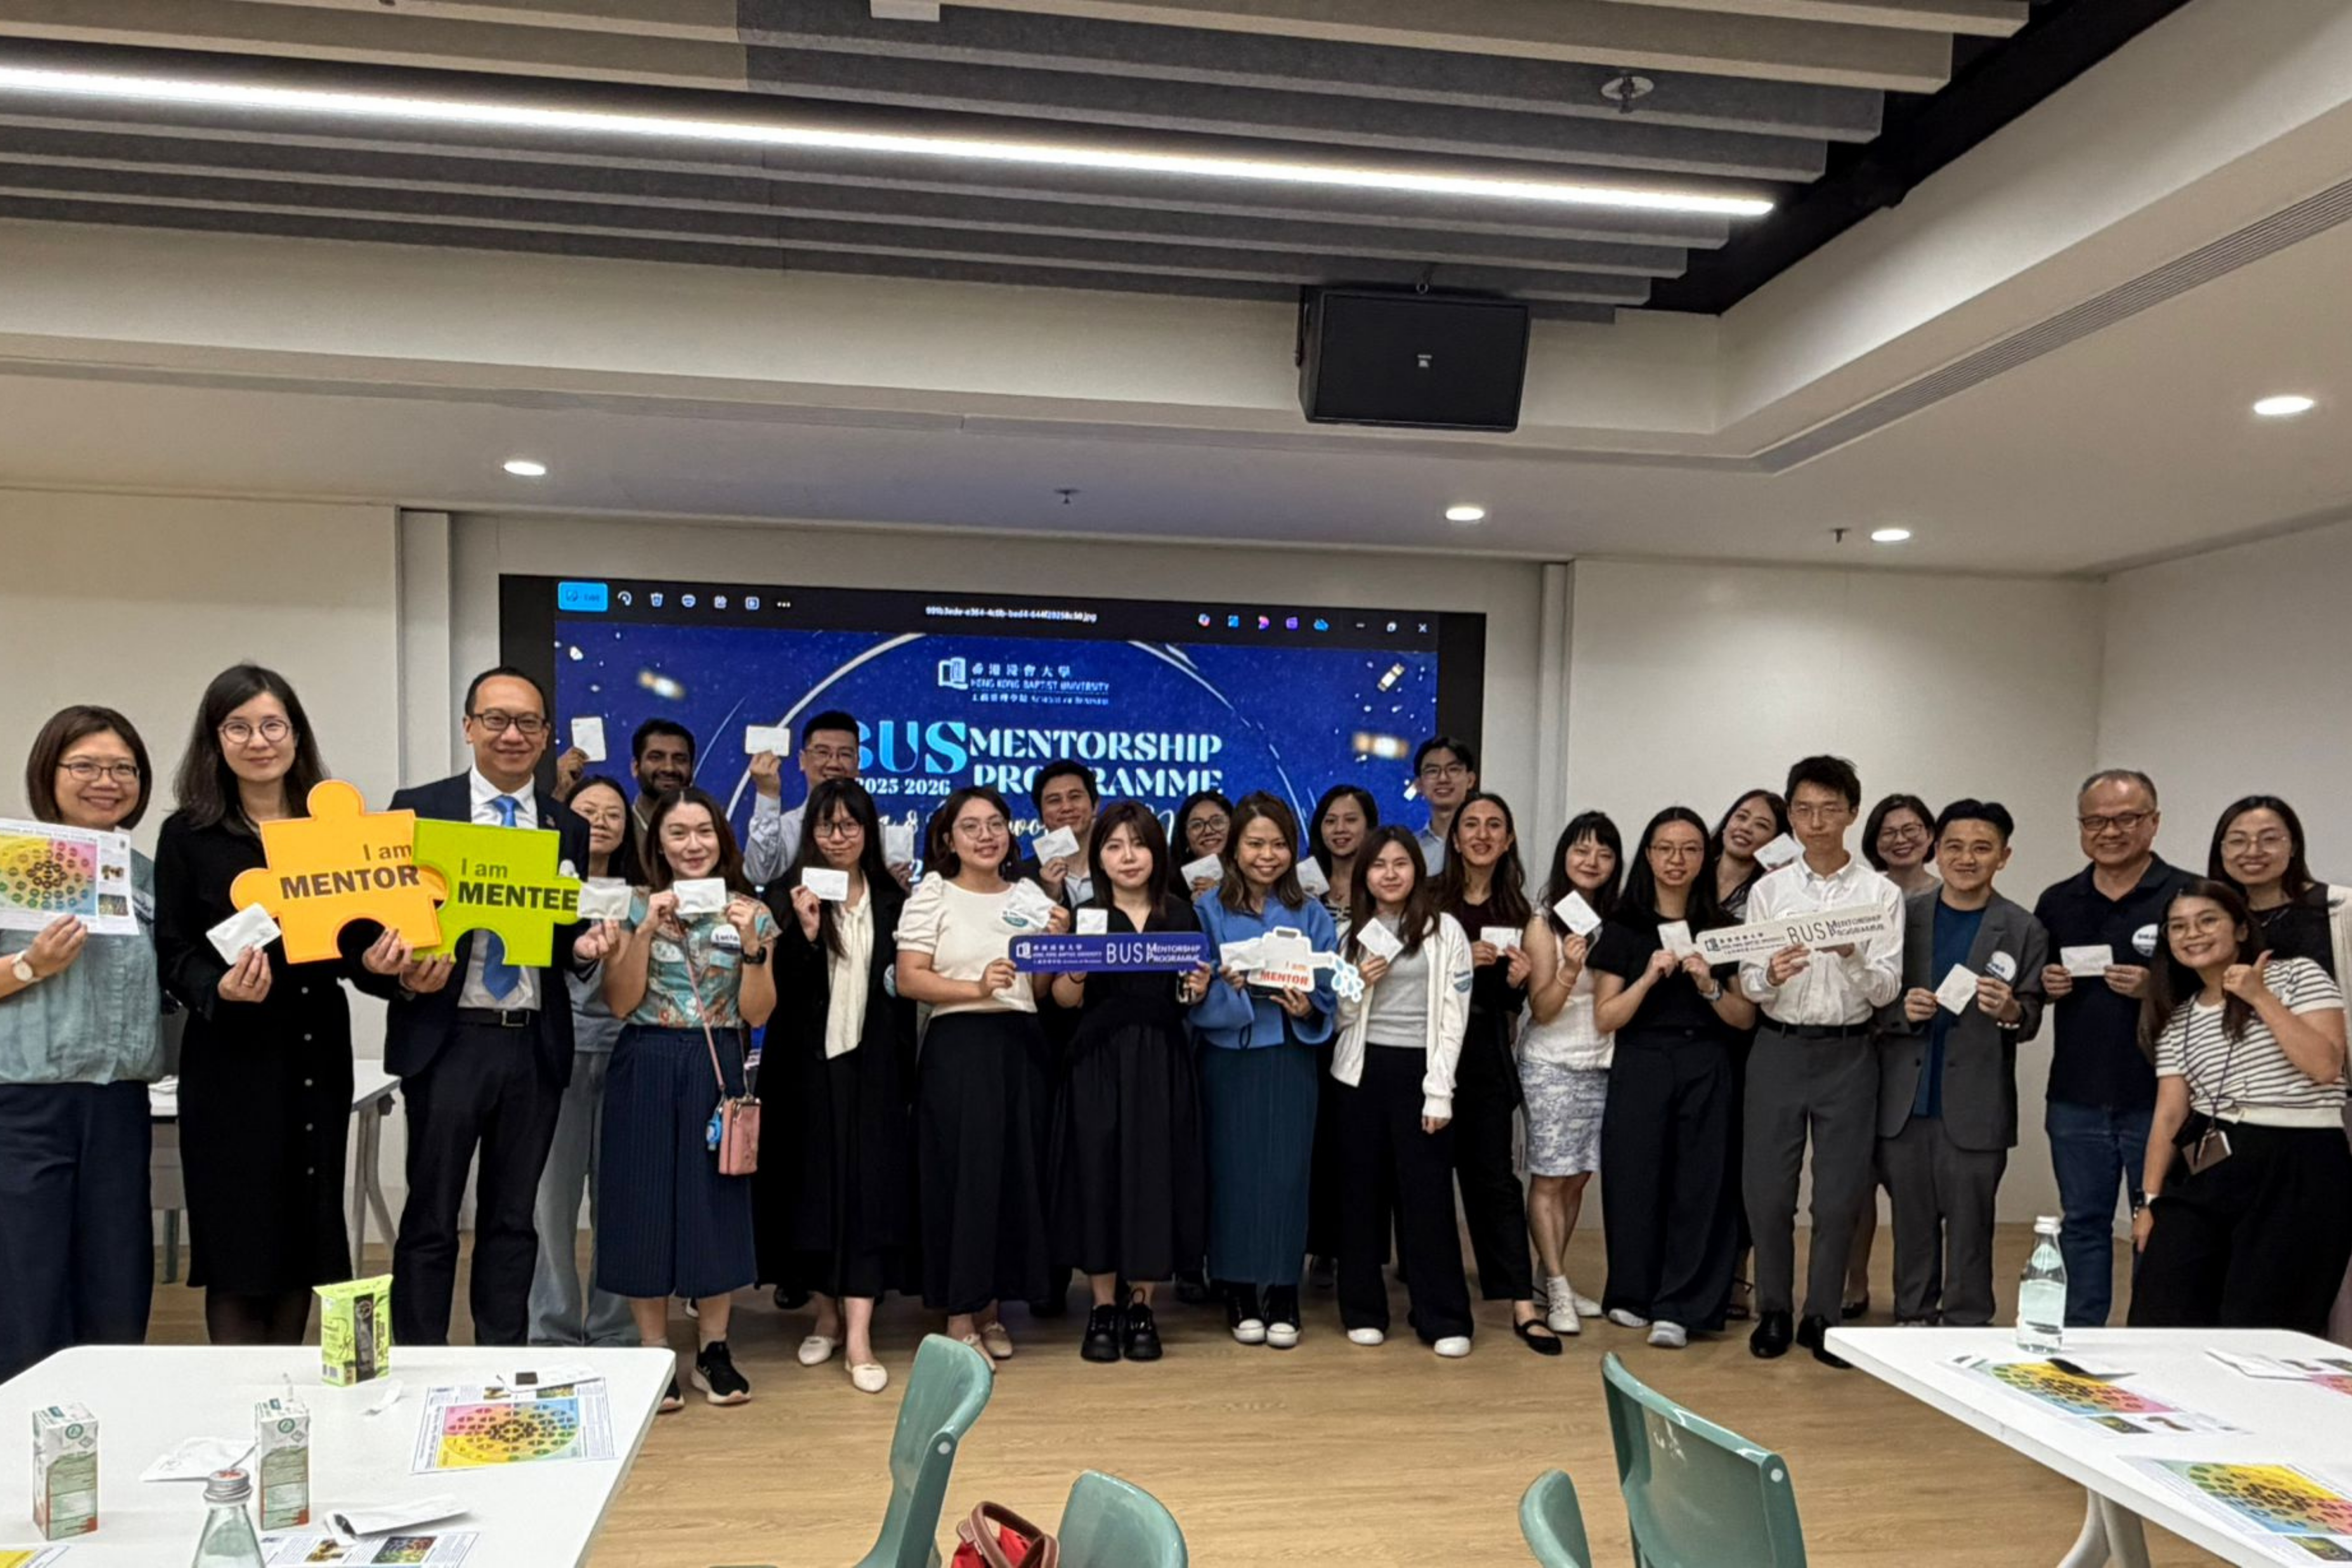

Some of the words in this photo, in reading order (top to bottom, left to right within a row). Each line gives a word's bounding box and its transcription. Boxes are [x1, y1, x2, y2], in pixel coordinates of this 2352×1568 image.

[970, 727, 1222, 763] MENTORSHIP
[973, 764, 1223, 798] PRRAMME
[363, 844, 371, 861] I
[378, 844, 412, 860] am
[461, 857, 467, 876] I
[475, 863, 508, 878] am
[280, 864, 420, 900] MENTOR
[458, 880, 580, 911] MENTEE
[1786, 922, 1826, 945] BUS
[1106, 942, 1143, 964] BUS
[1260, 970, 1309, 985] MENTOR
